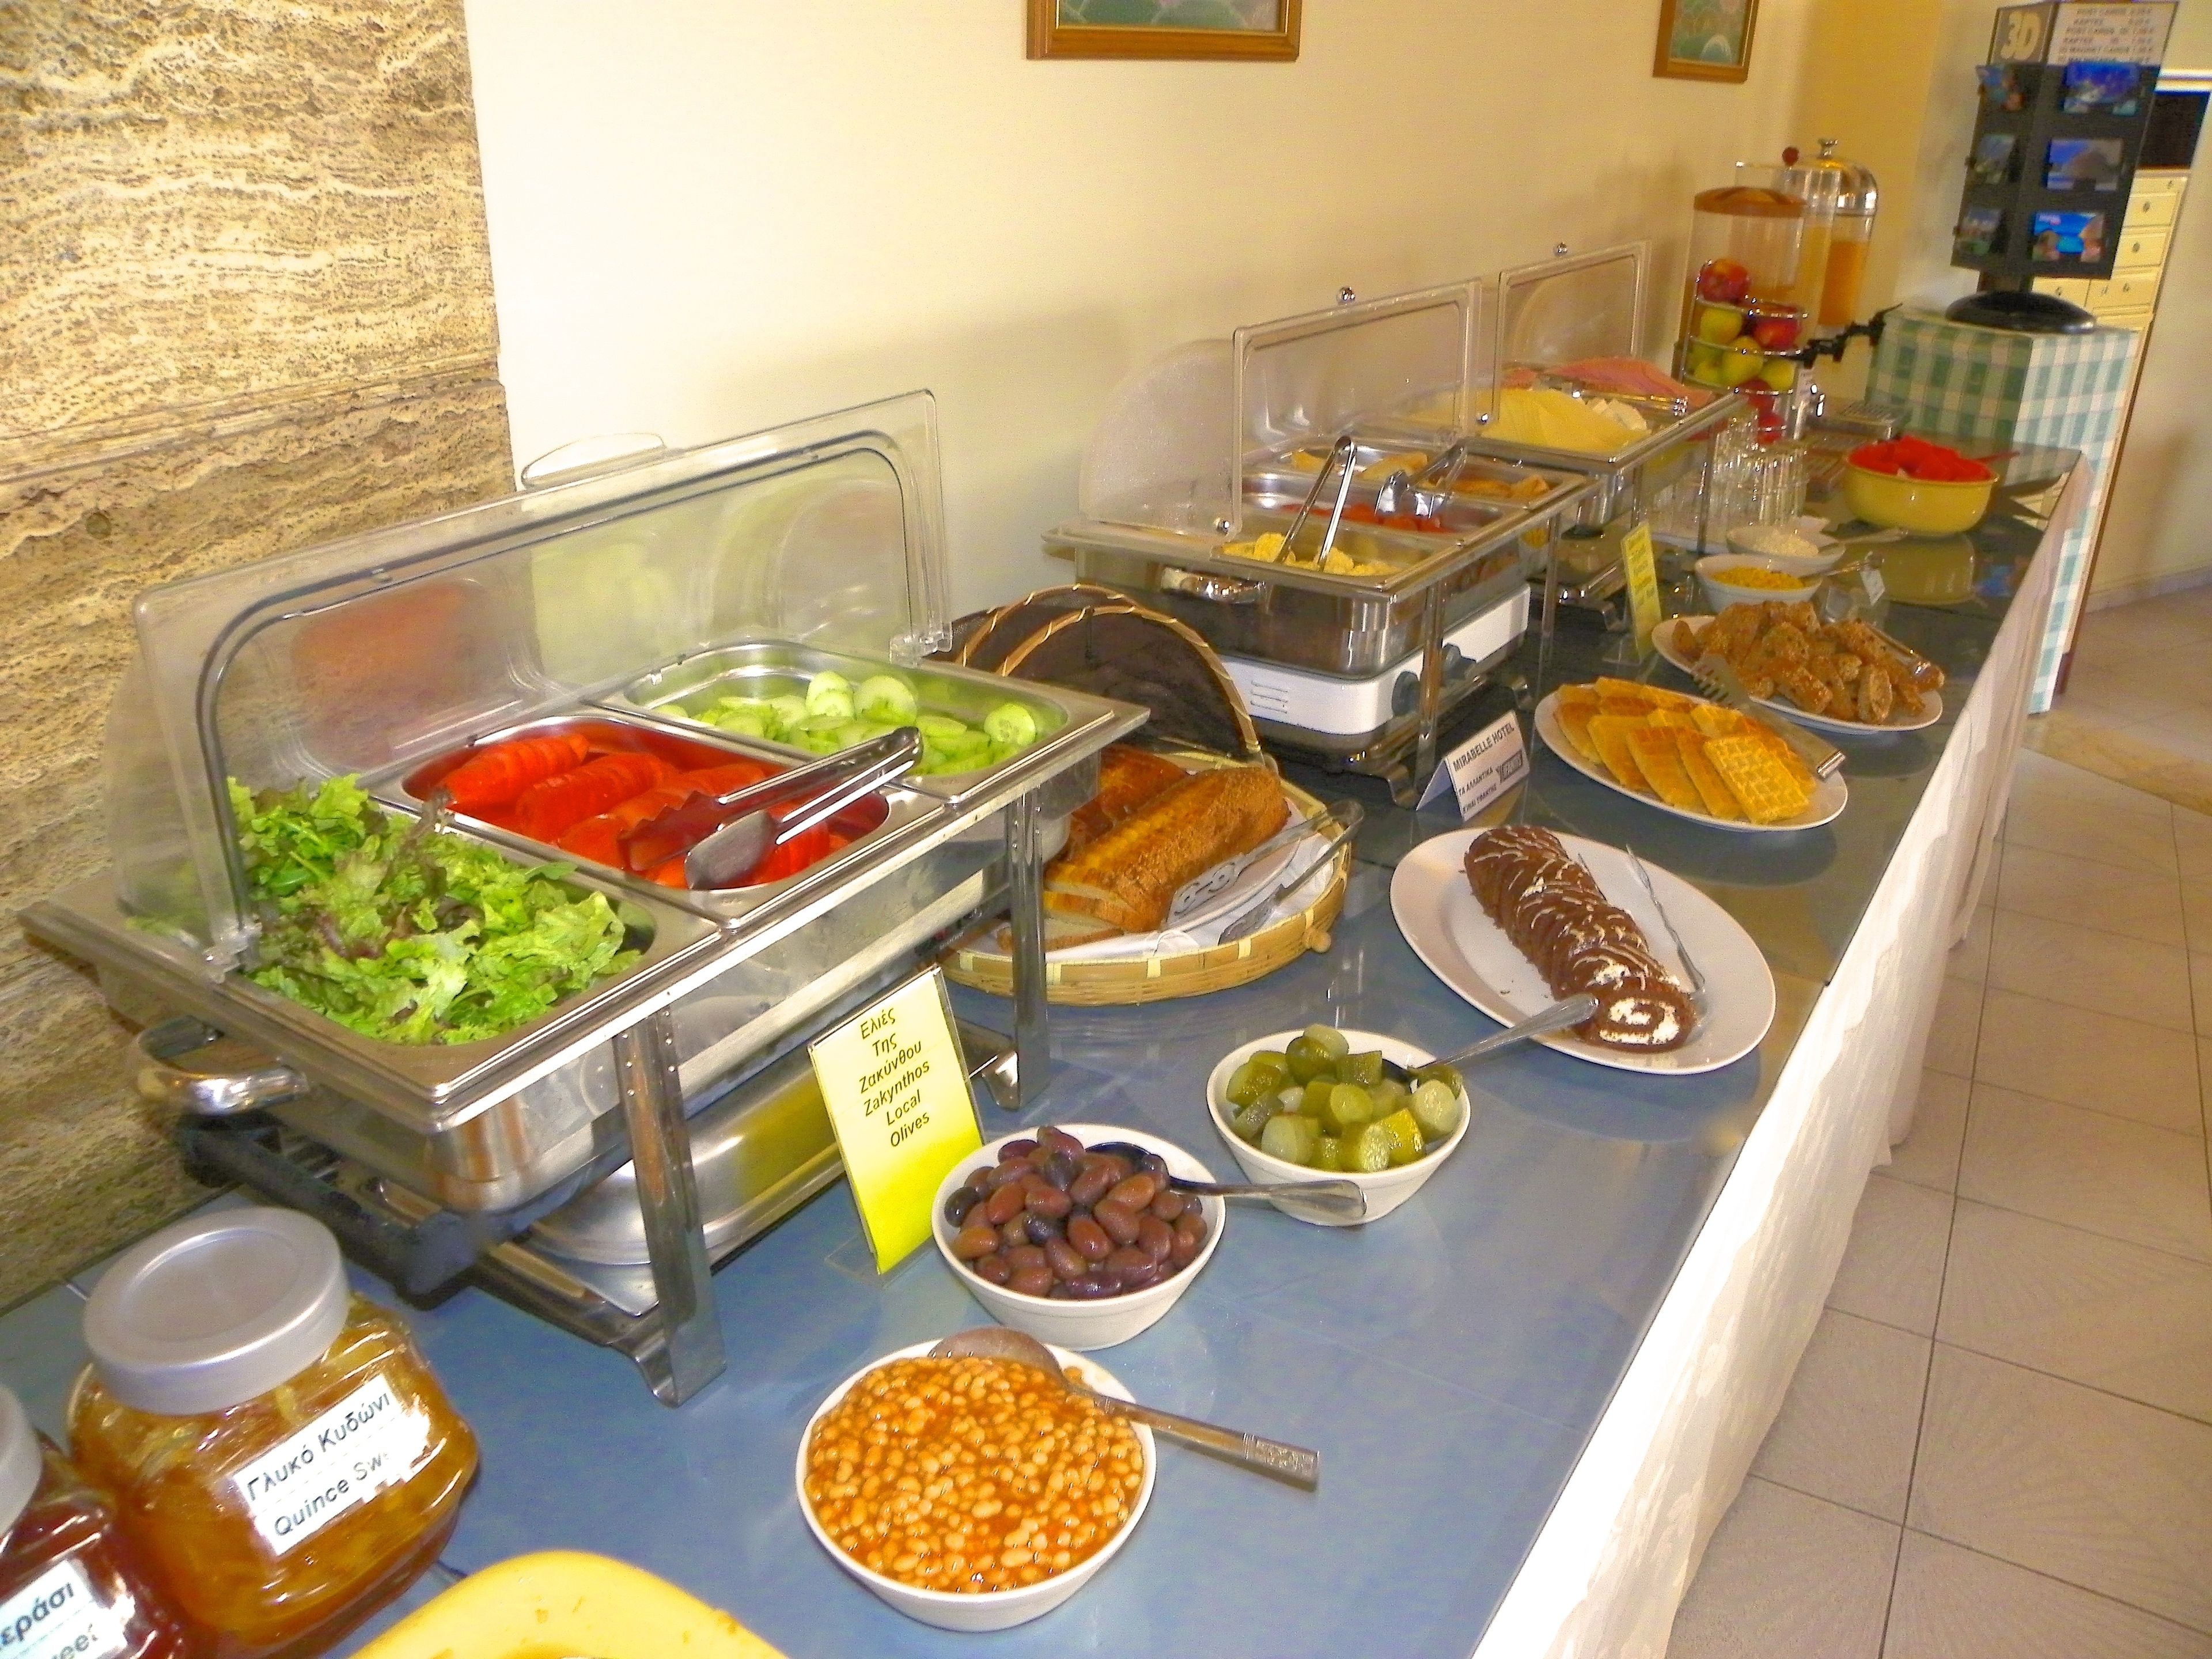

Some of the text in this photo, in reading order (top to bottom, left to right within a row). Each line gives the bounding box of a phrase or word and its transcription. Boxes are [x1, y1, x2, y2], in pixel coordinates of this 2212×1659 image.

[2000, 10, 2041, 60] 3D
[1453, 737, 1493, 772] MIRABELLE
[1492, 723, 1515, 744] HOTEL
[860, 1007, 896, 1040] Ελιές
[872, 1033, 897, 1057] Της
[859, 1040, 922, 1094] Ζακύνθου
[863, 1061, 930, 1117] Zakynthos
[886, 1089, 921, 1126] Local
[891, 1112, 930, 1147] Olives
[247, 1393, 391, 1501] Γλυκό Κυδώνι
[274, 1479, 350, 1536] Quince
[0, 1582, 74, 1646] εράσι
